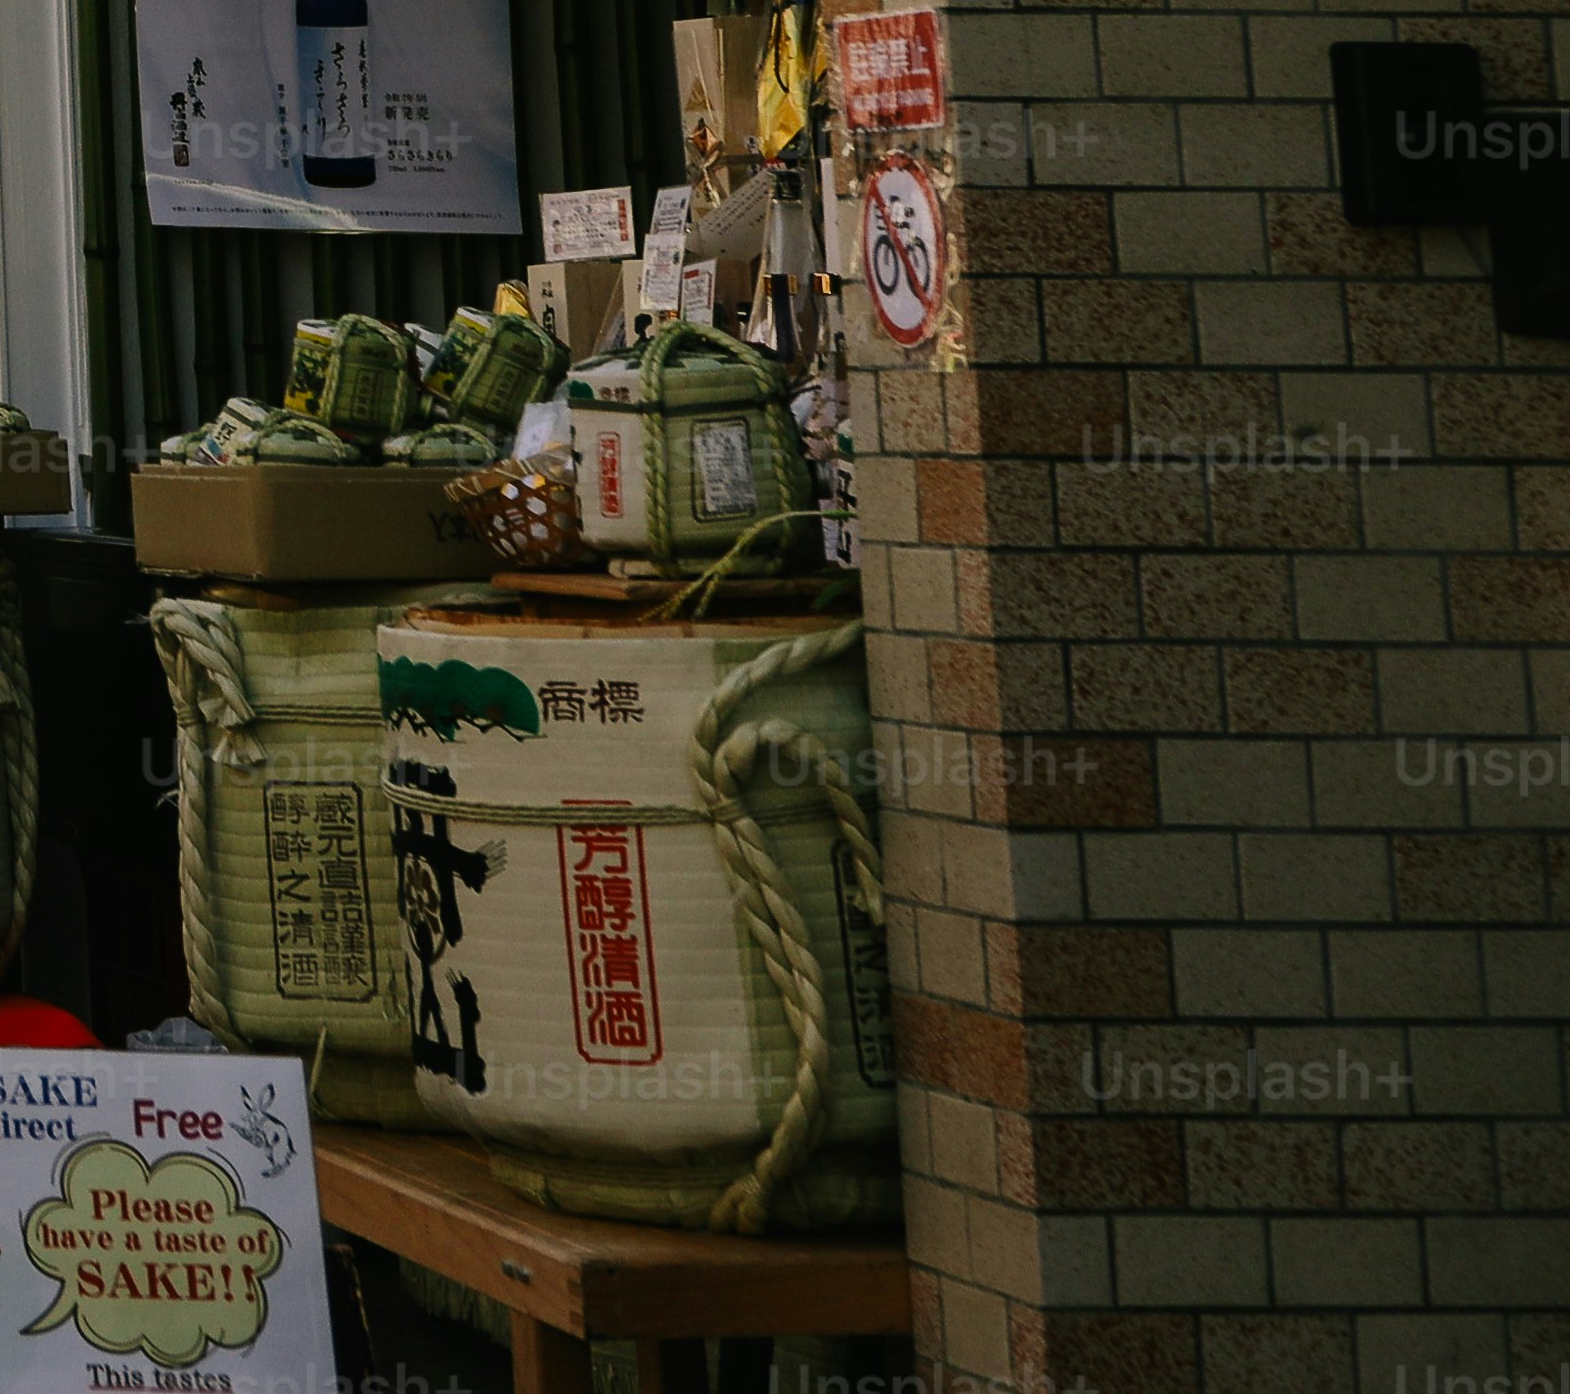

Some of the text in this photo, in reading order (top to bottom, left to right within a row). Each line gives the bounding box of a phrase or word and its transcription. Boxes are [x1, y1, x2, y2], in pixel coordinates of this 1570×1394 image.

[537, 678, 647, 726] 商標
[132, 1098, 225, 1141] Free
[88, 1187, 216, 1225] Please
[41, 1224, 270, 1255] have a taste of
[75, 1259, 259, 1303] SAKE!!
[85, 1363, 235, 1392] This tastes
